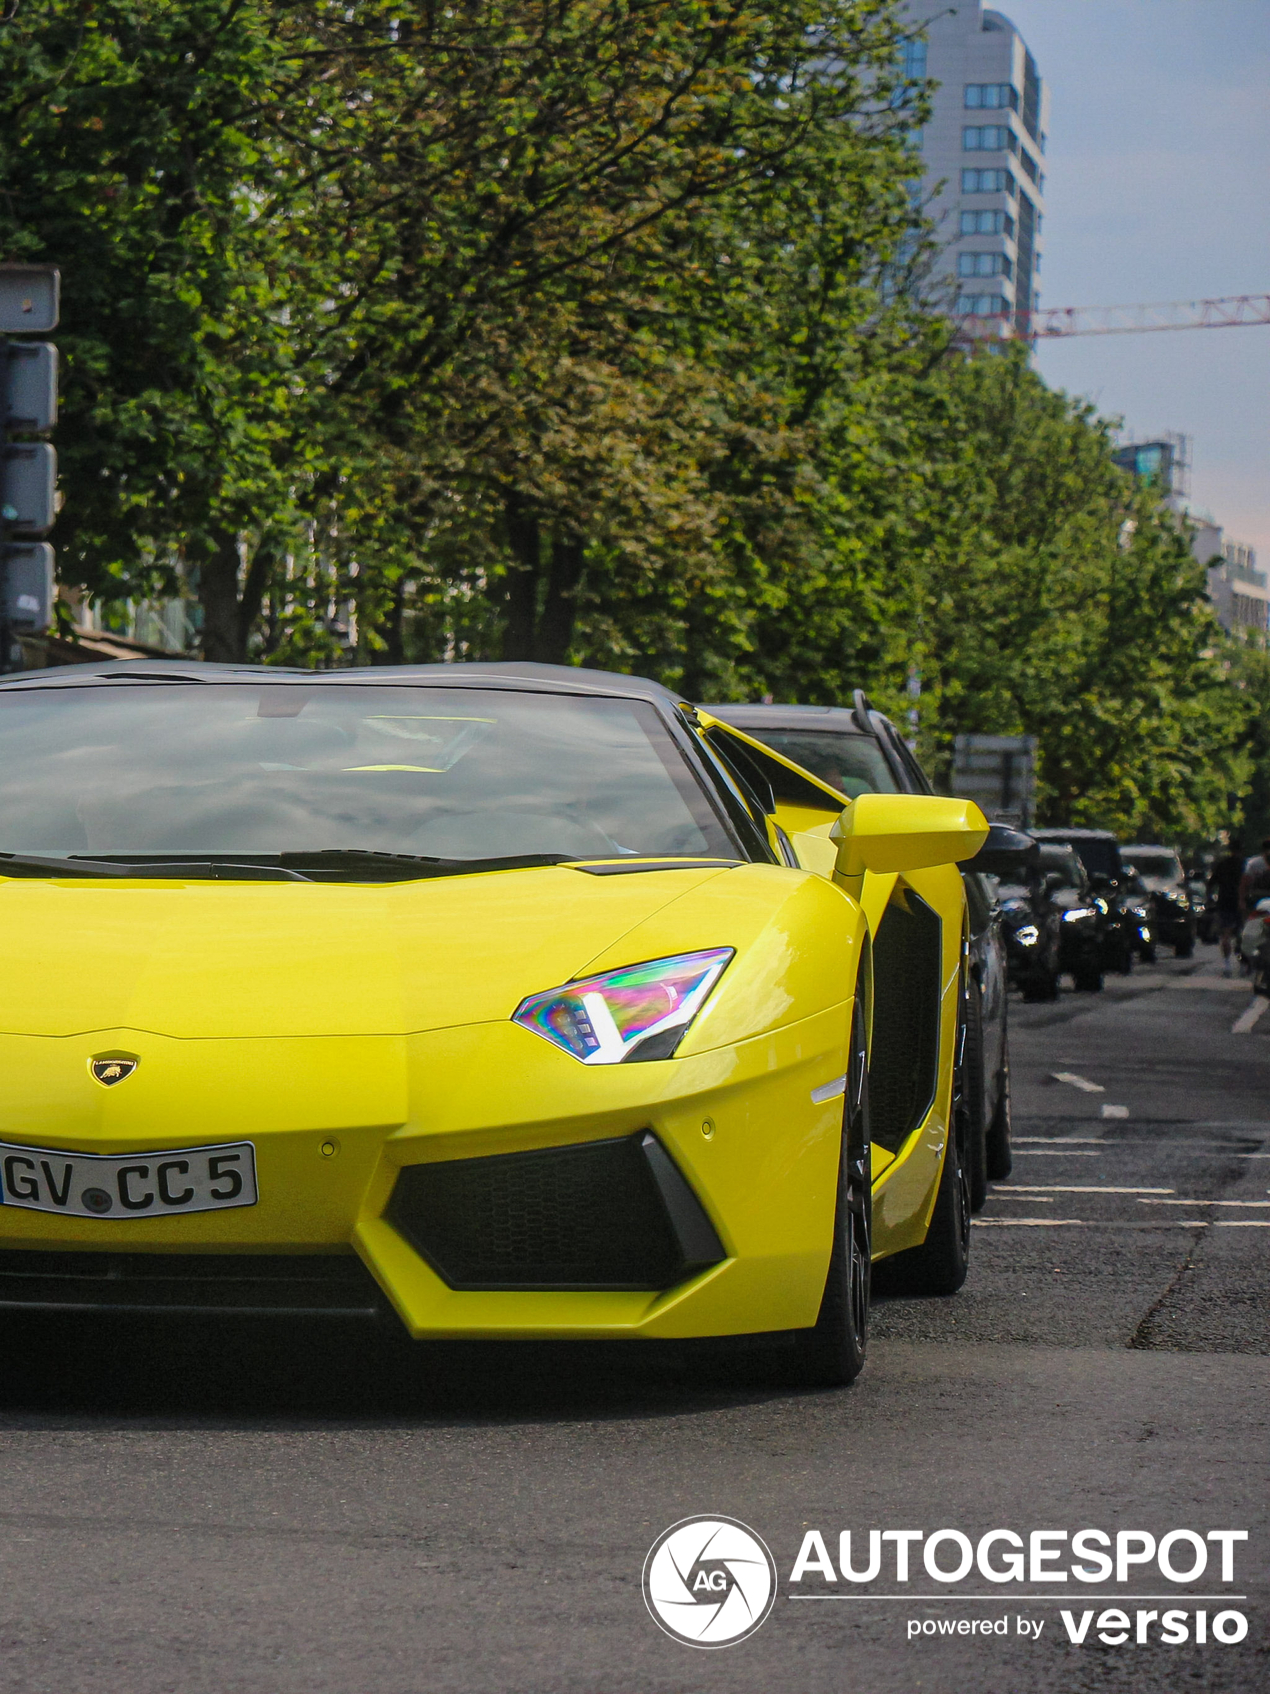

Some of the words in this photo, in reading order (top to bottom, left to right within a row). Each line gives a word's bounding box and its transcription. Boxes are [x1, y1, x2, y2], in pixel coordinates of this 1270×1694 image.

[3, 1155, 73, 1206] GV
[116, 1159, 194, 1210] CC
[208, 1153, 243, 1201] 5
